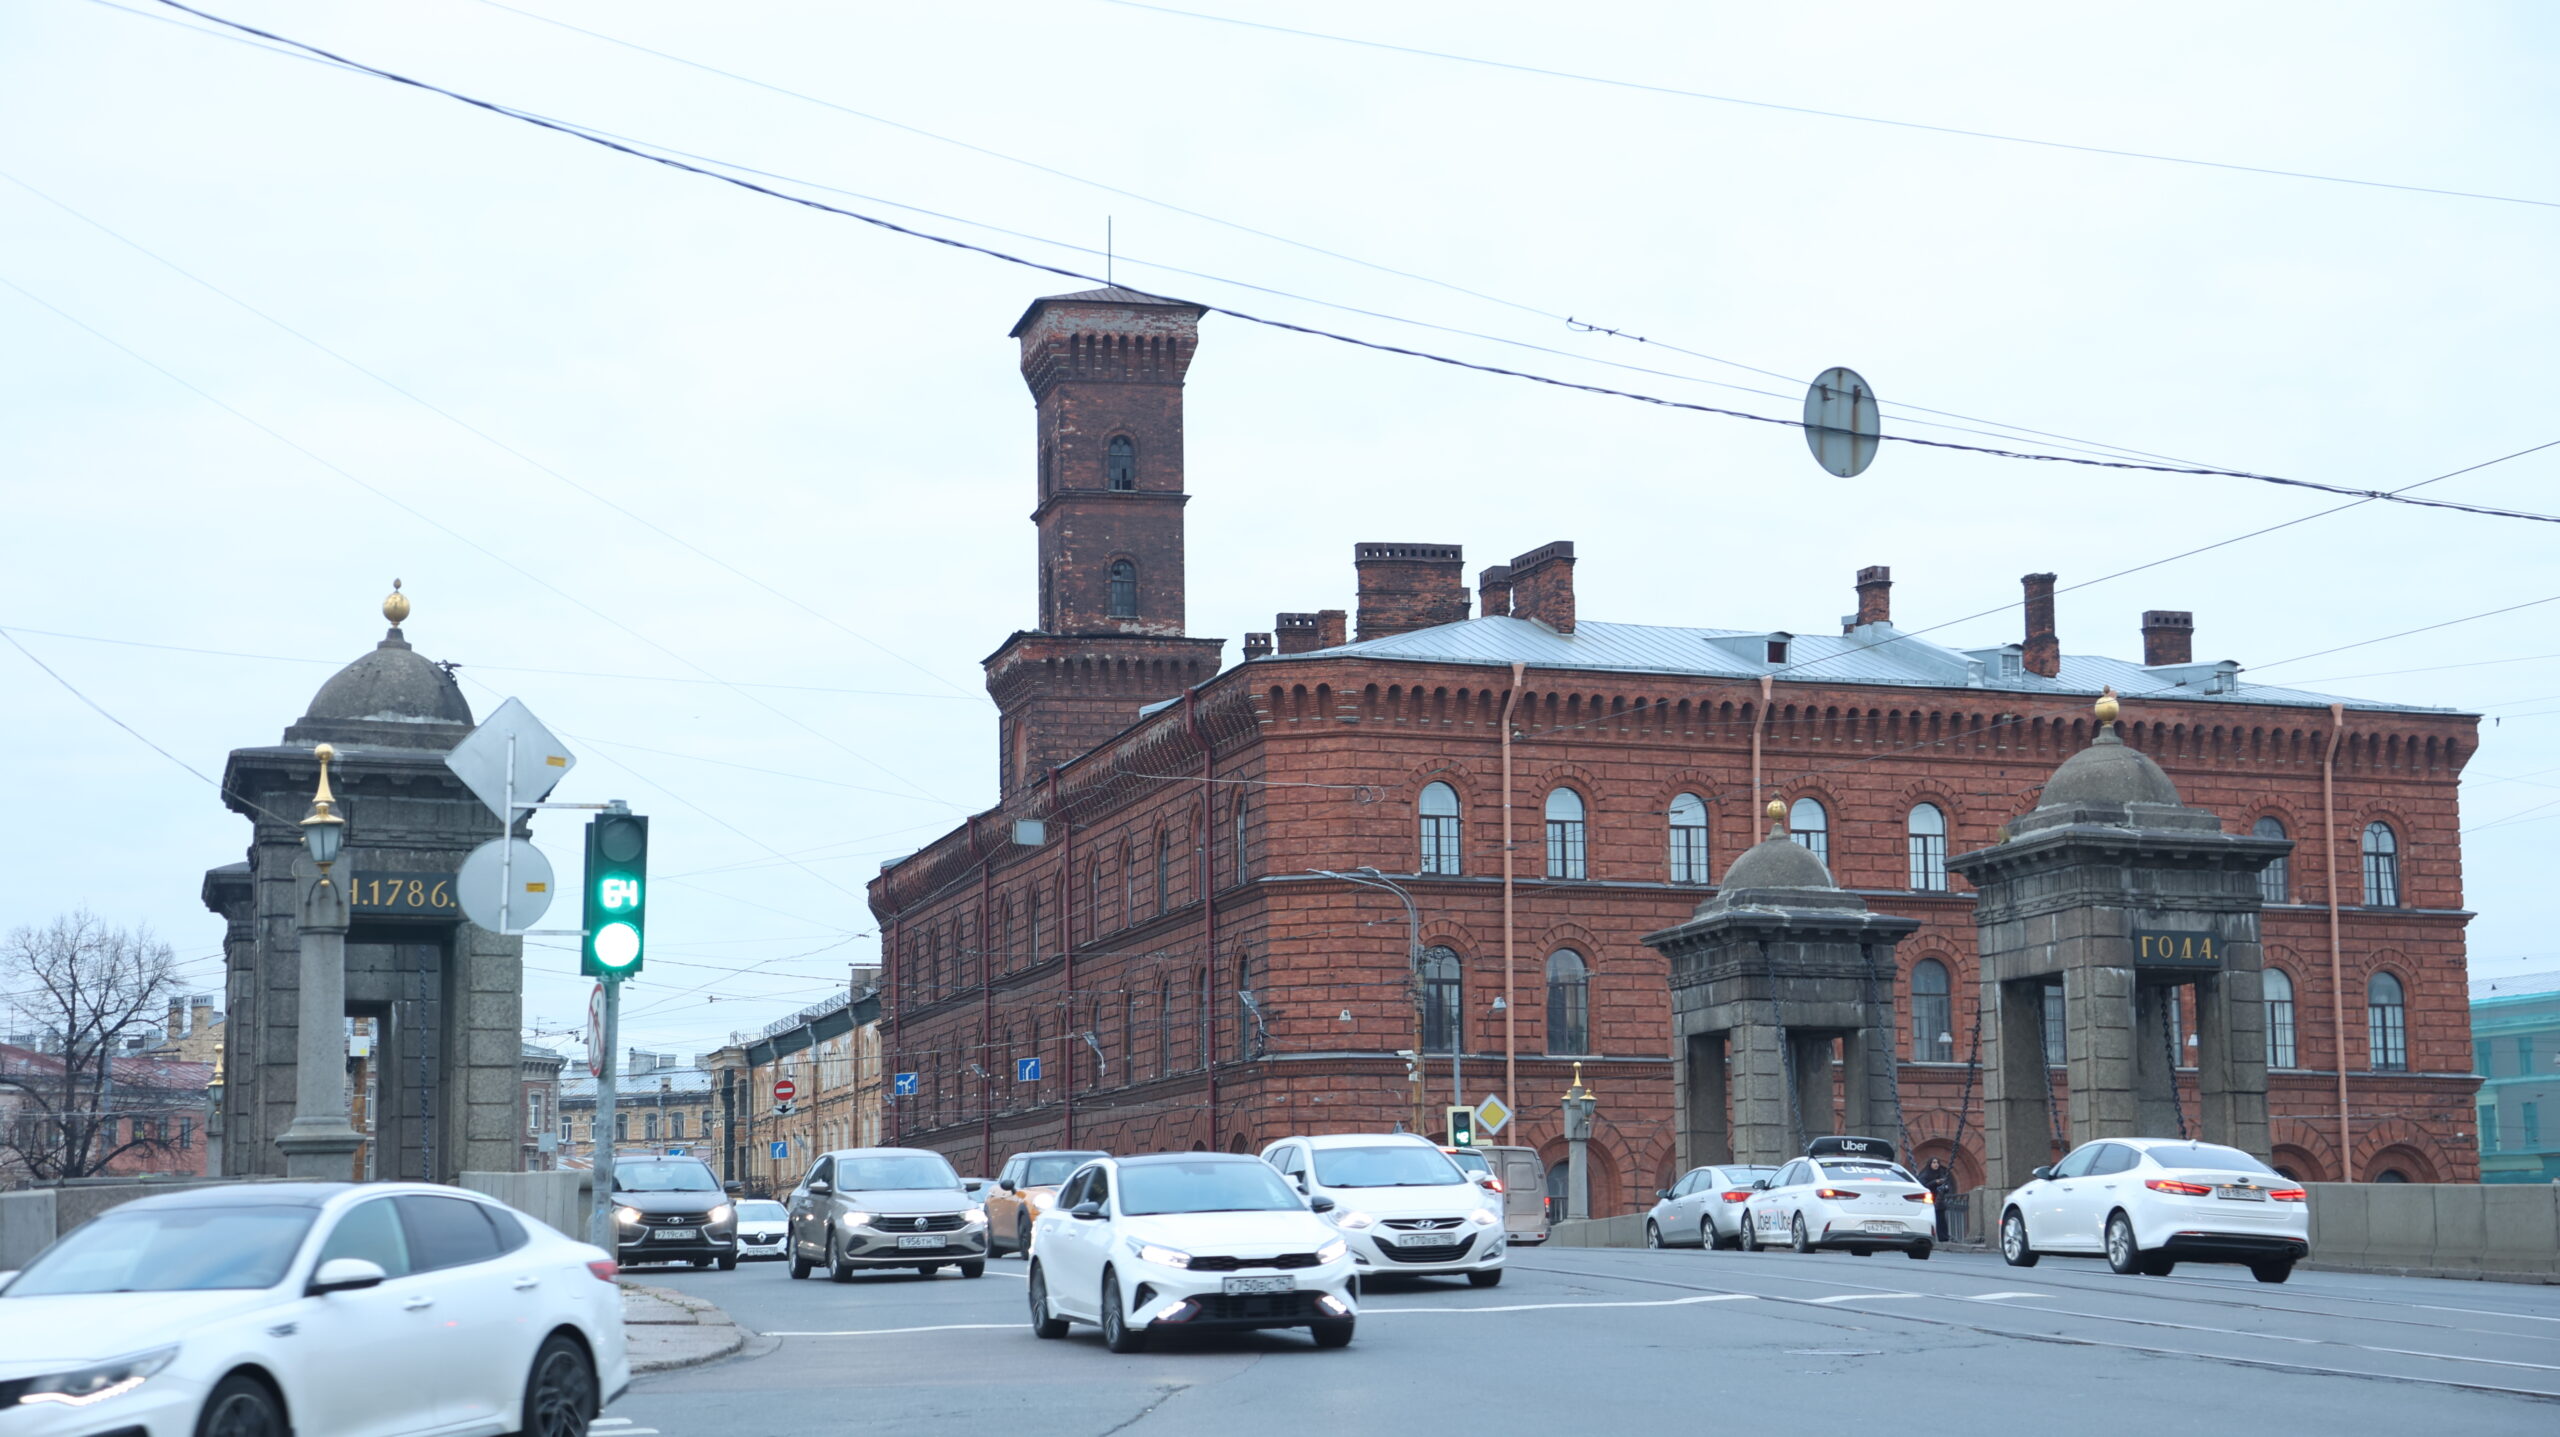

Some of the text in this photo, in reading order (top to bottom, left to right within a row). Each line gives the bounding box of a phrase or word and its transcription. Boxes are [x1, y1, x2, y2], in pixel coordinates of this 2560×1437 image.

[602, 878, 639, 908] 64
[2140, 935, 2219, 960] ГОДА.
[1841, 1140, 1868, 1151] Uber
[1840, 1166, 1891, 1175] Uber
[1777, 1209, 1792, 1231] Ube
